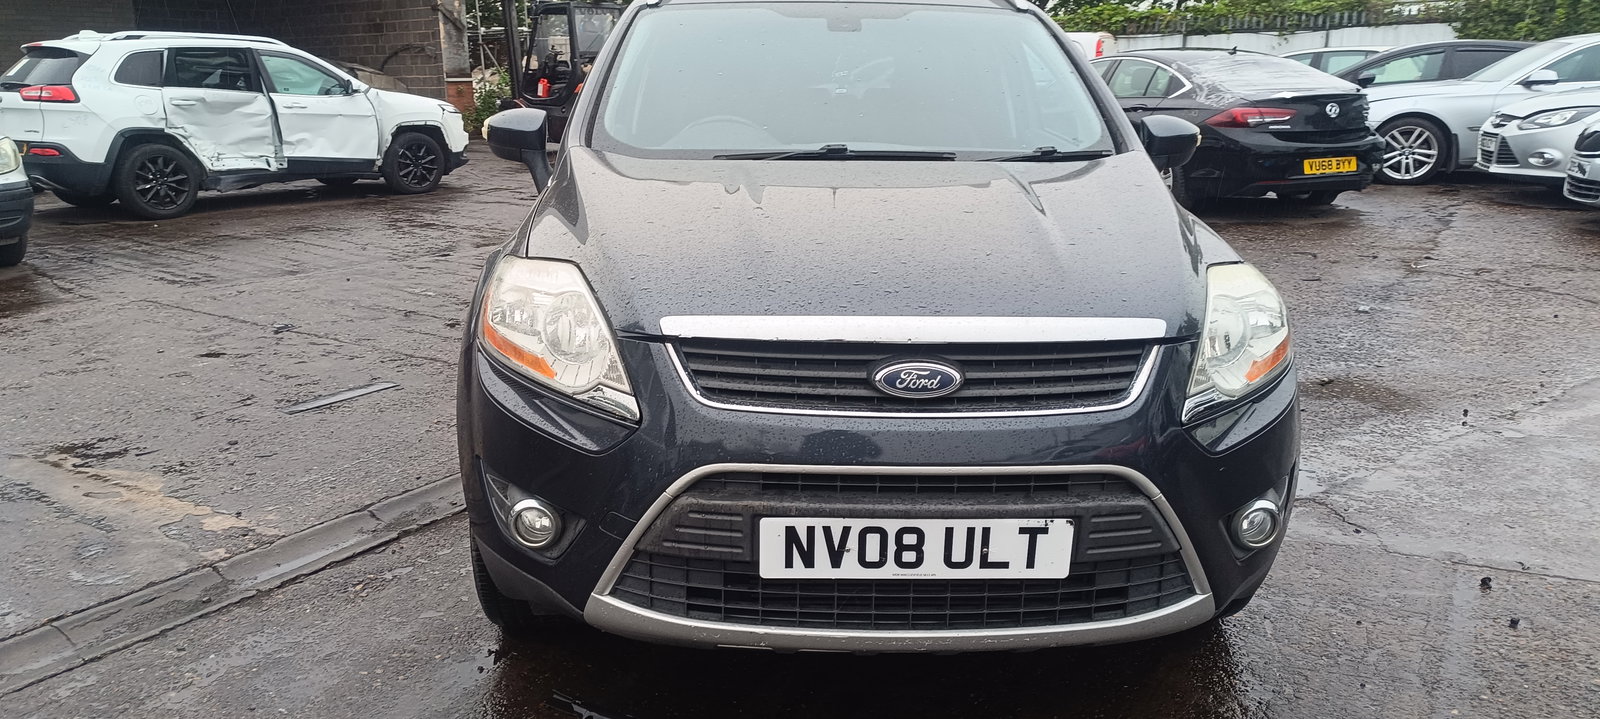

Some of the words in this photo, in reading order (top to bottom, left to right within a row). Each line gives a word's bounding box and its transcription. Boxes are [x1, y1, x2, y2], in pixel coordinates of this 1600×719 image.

[1308, 160, 1332, 171] VU68
[1335, 158, 1352, 170] BYY
[896, 369, 941, 389] Ford
[784, 525, 926, 569] NV08
[943, 526, 1049, 569] ULT
